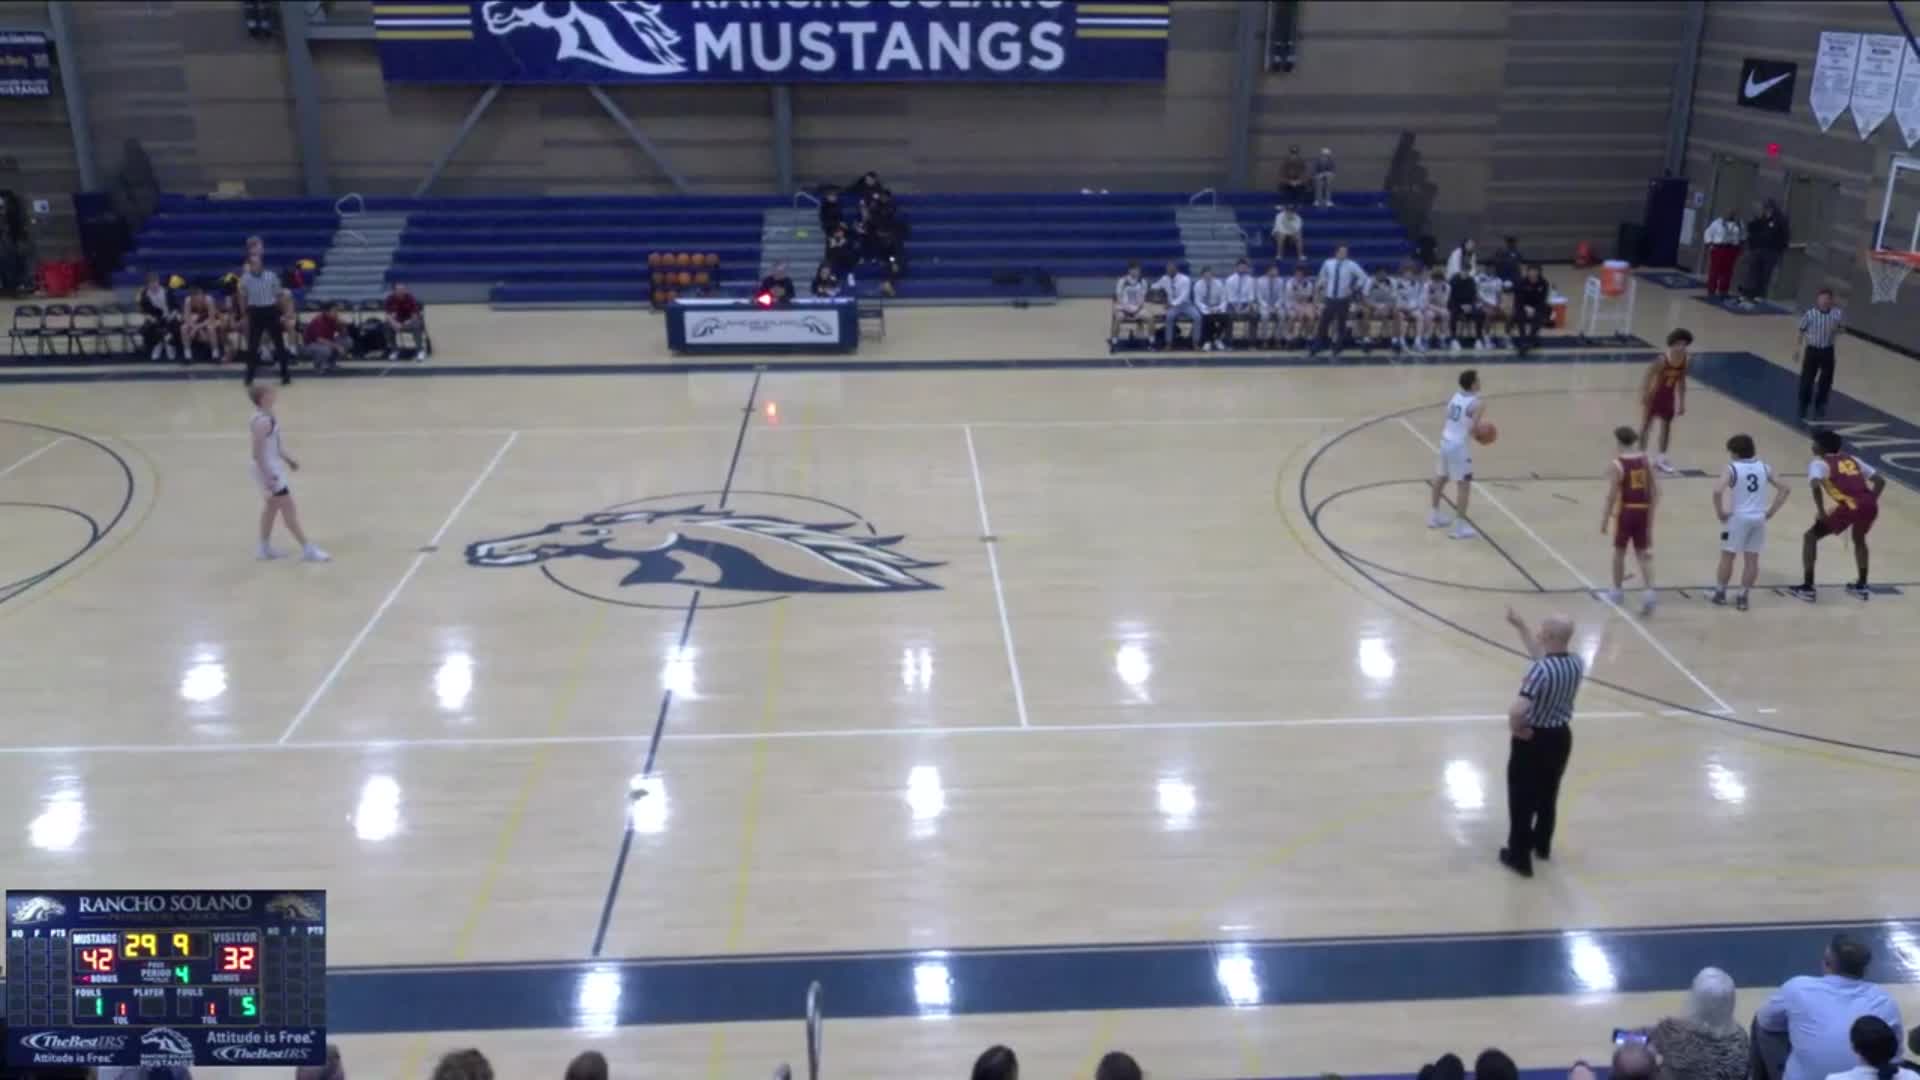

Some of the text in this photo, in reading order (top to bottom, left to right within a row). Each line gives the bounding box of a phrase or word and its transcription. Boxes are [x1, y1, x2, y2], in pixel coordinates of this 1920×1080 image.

[694, 21, 1065, 72] MUSTANGS
[1838, 459, 1859, 476] 42
[1746, 473, 1759, 493] 3
